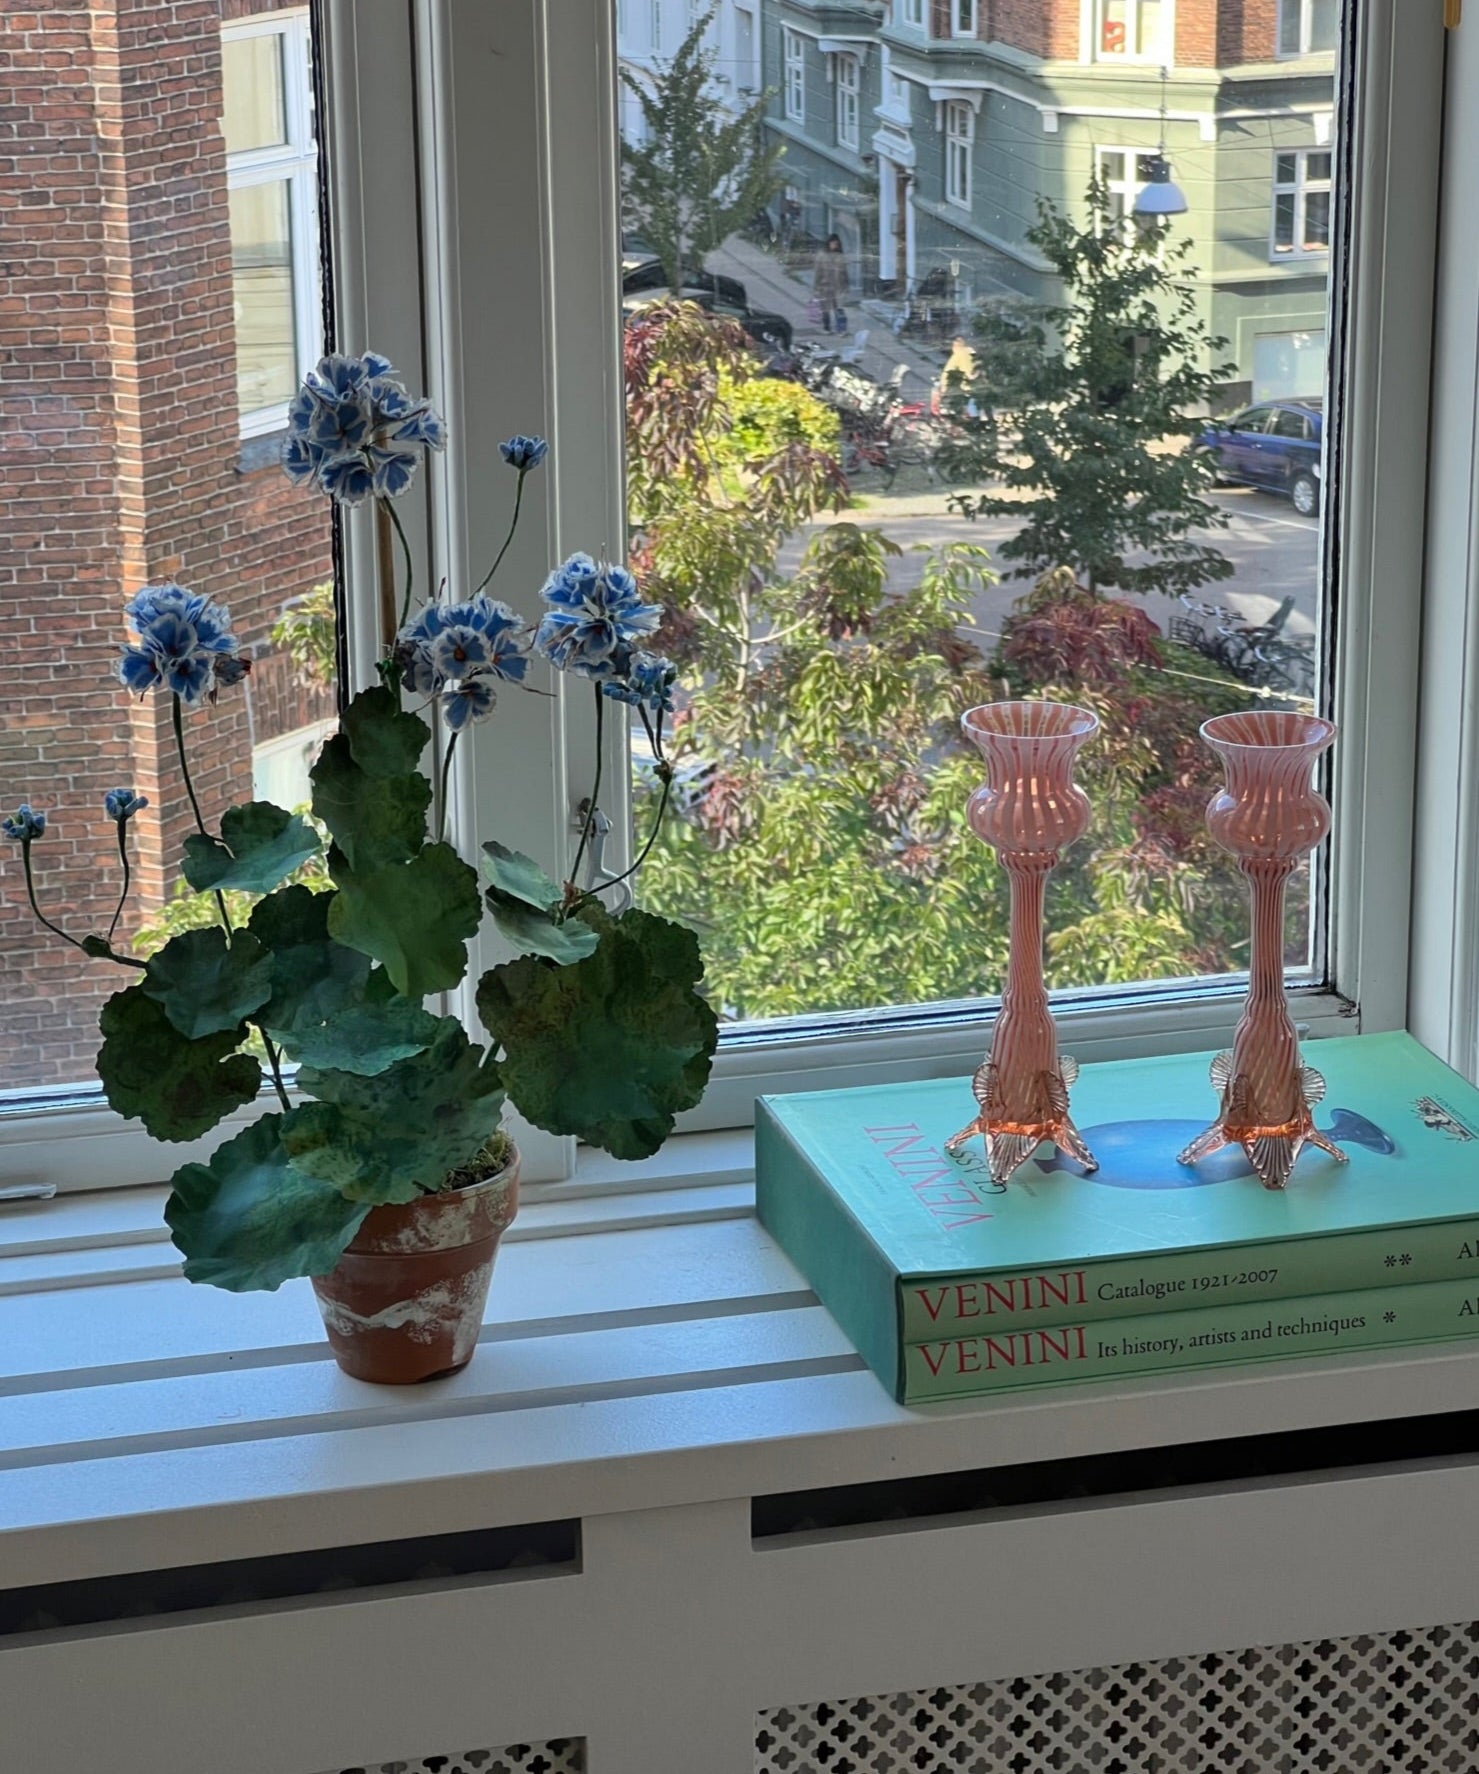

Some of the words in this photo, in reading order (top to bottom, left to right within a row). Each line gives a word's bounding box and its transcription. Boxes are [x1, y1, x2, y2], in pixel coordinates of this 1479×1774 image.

[863, 1122, 995, 1230] VENINI
[914, 1271, 1089, 1321] VENINI
[1097, 1279, 1186, 1301] Catalogue
[1457, 1297, 1479, 1316] A
[915, 1326, 1089, 1377] VENINI
[1097, 1341, 1118, 1359] Its
[1122, 1337, 1184, 1356] history,
[1189, 1328, 1237, 1348] artists
[1240, 1321, 1273, 1342] and
[1277, 1314, 1366, 1338] techniques
